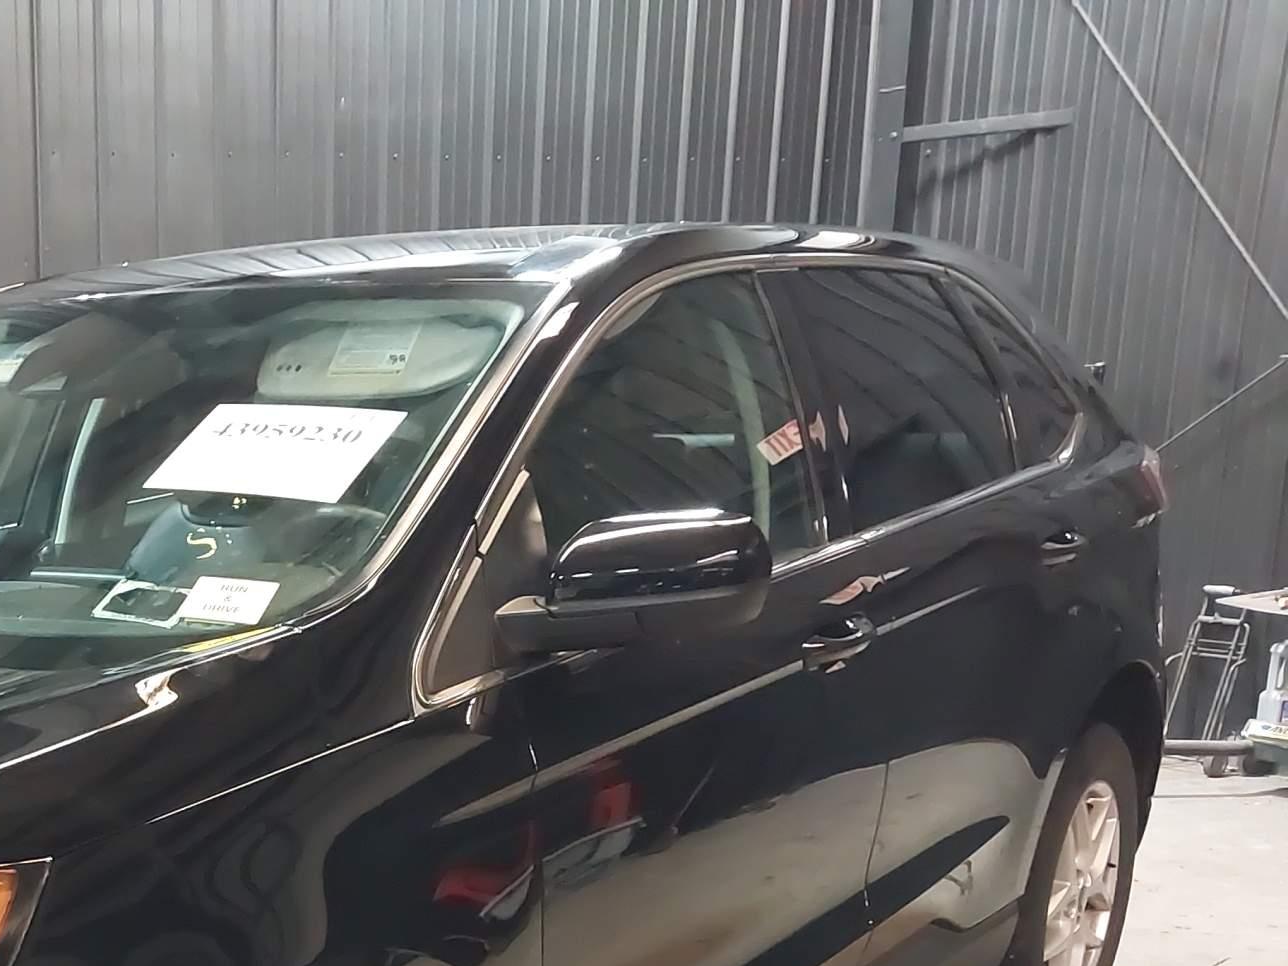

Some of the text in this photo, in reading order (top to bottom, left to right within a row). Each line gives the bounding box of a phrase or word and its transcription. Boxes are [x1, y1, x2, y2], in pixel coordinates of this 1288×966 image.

[212, 423, 363, 444] 43959230
[219, 584, 249, 593] RUN
[202, 603, 241, 613] DRIVE
